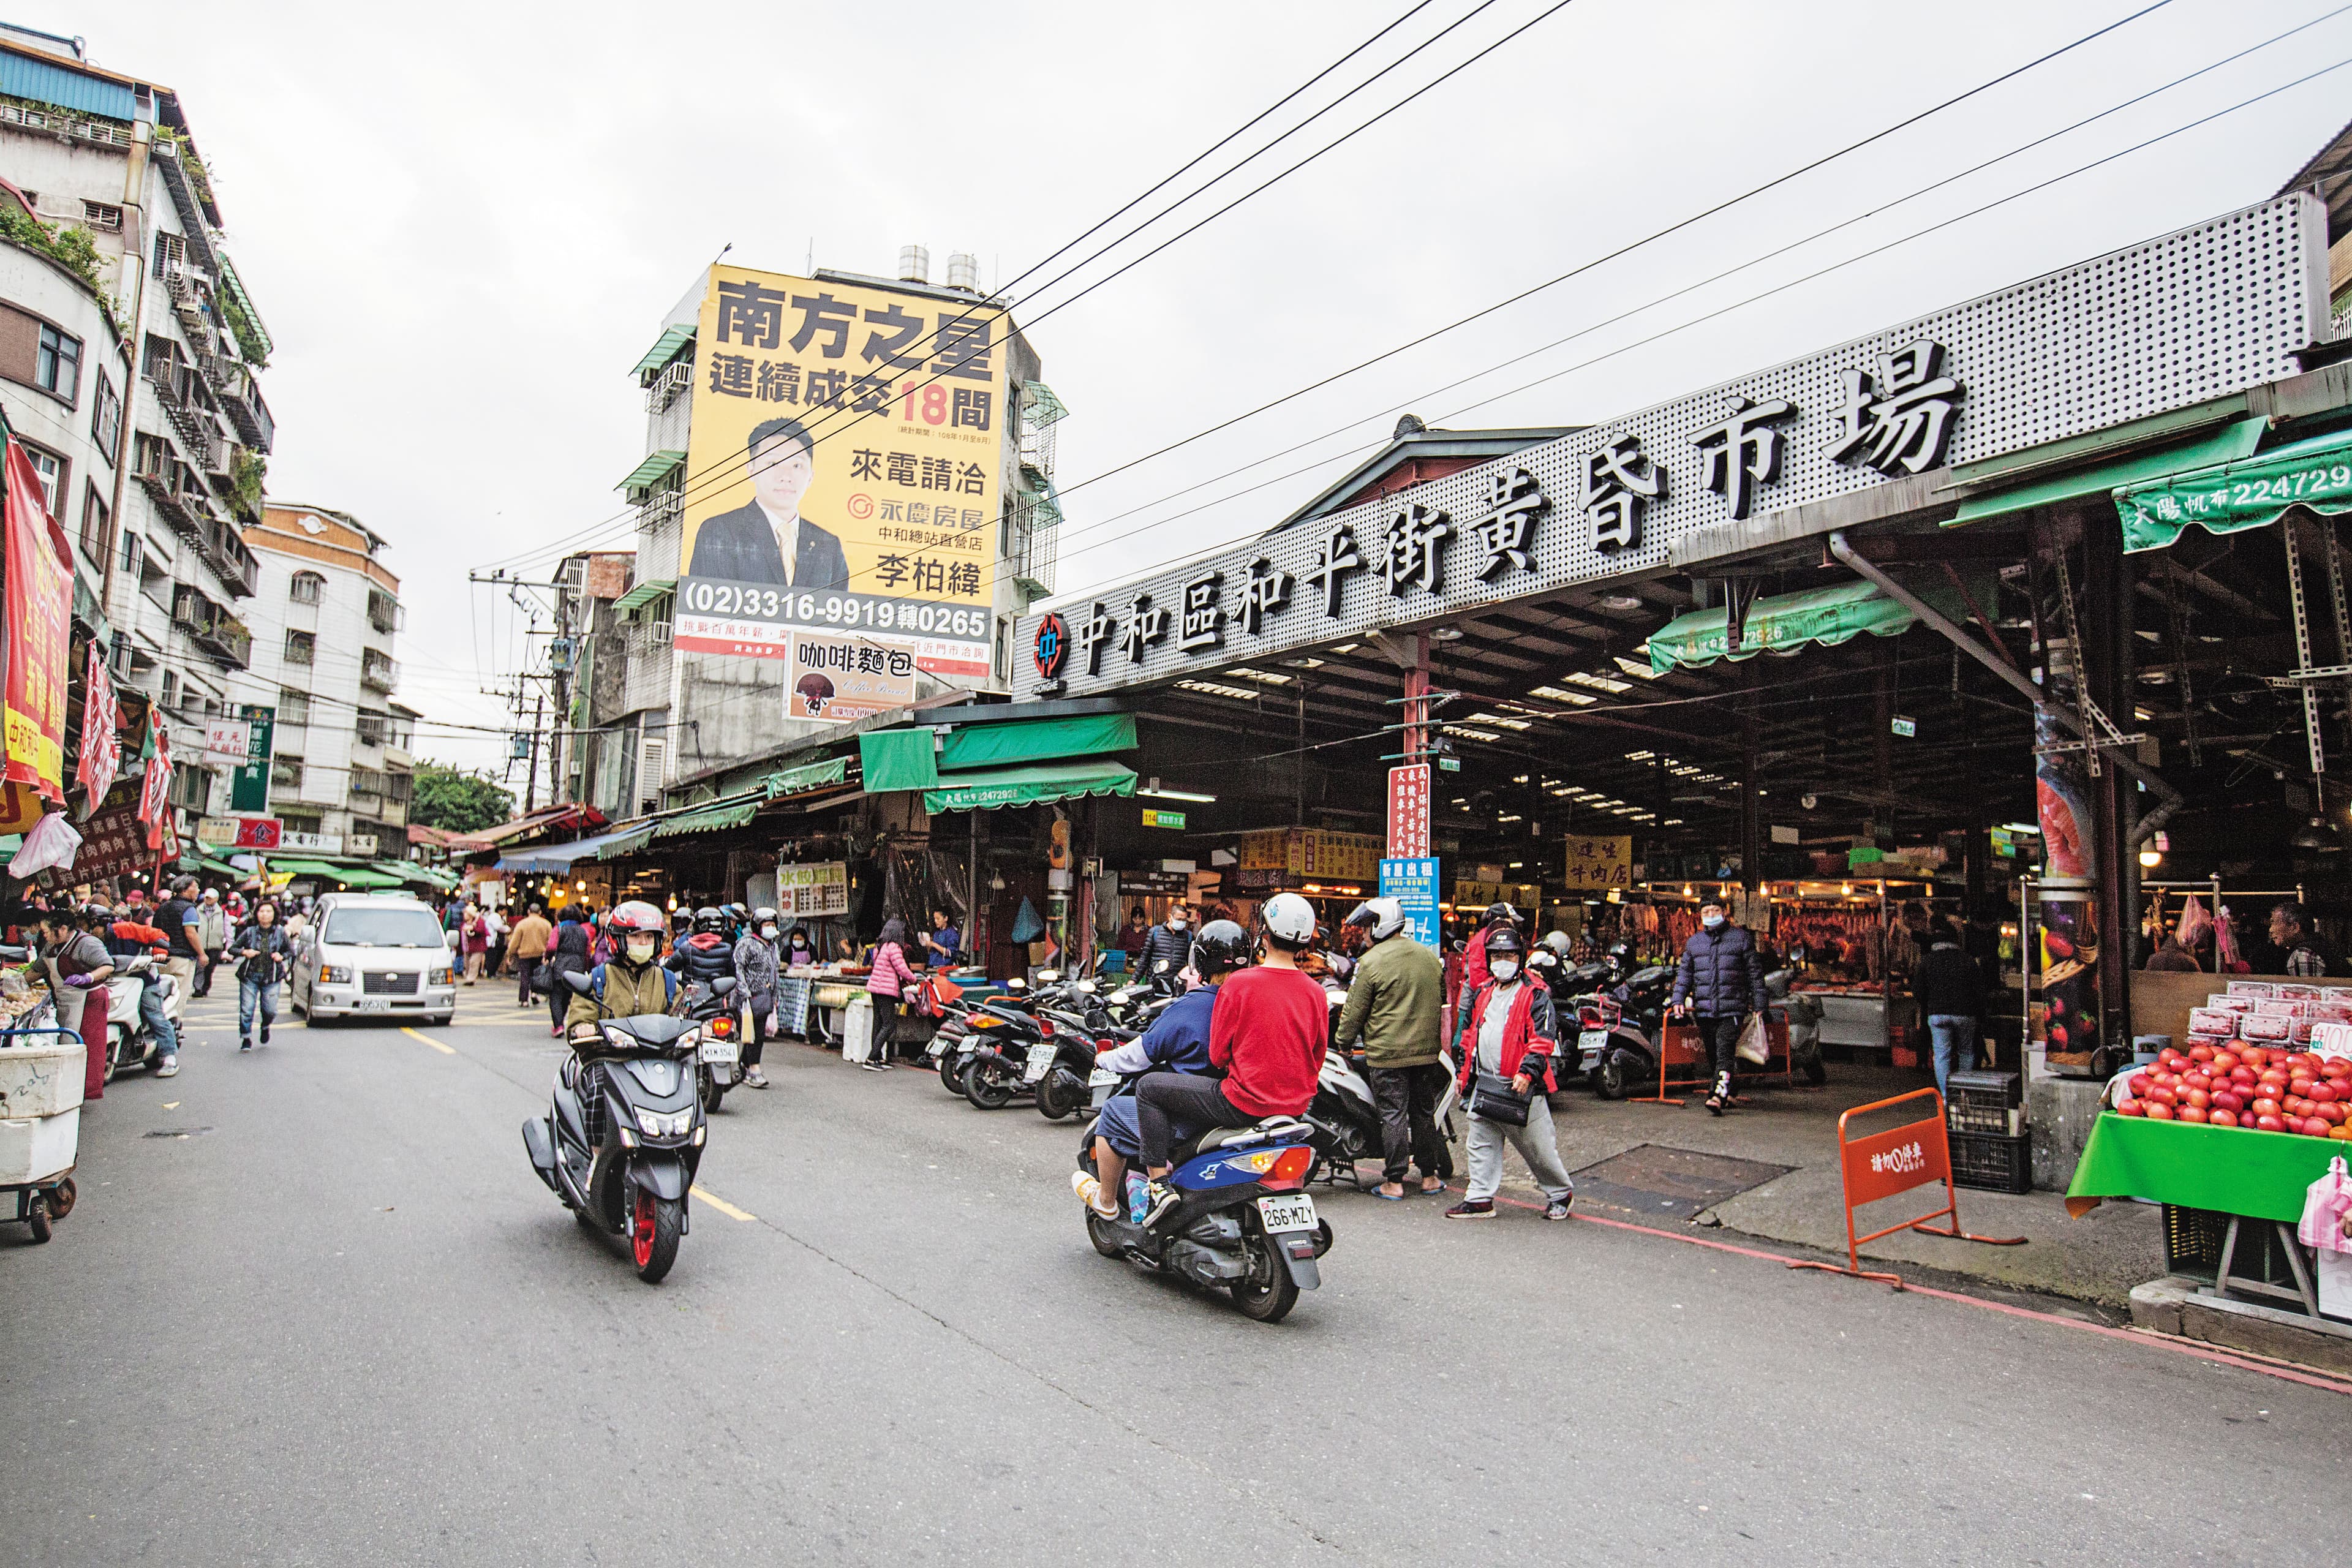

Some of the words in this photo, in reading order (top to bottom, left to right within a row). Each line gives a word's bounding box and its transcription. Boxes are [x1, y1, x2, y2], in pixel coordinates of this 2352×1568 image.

[717, 279, 992, 382] 南方之星
[709, 350, 992, 431] 連續成交18間
[850, 448, 986, 496] 來電請洽
[880, 499, 984, 531] 永慶房屋
[1077, 339, 1967, 676] 中和區和平街黃昏市場
[878, 527, 982, 551] 中和總站直營店
[876, 554, 981, 597] 李柏緯
[685, 581, 986, 637] (02)3316-9919轉0265
[799, 641, 912, 677] 咖啡麵包
[1145, 813, 1156, 823] 114
[1382, 862, 1433, 877] 新屋出租
